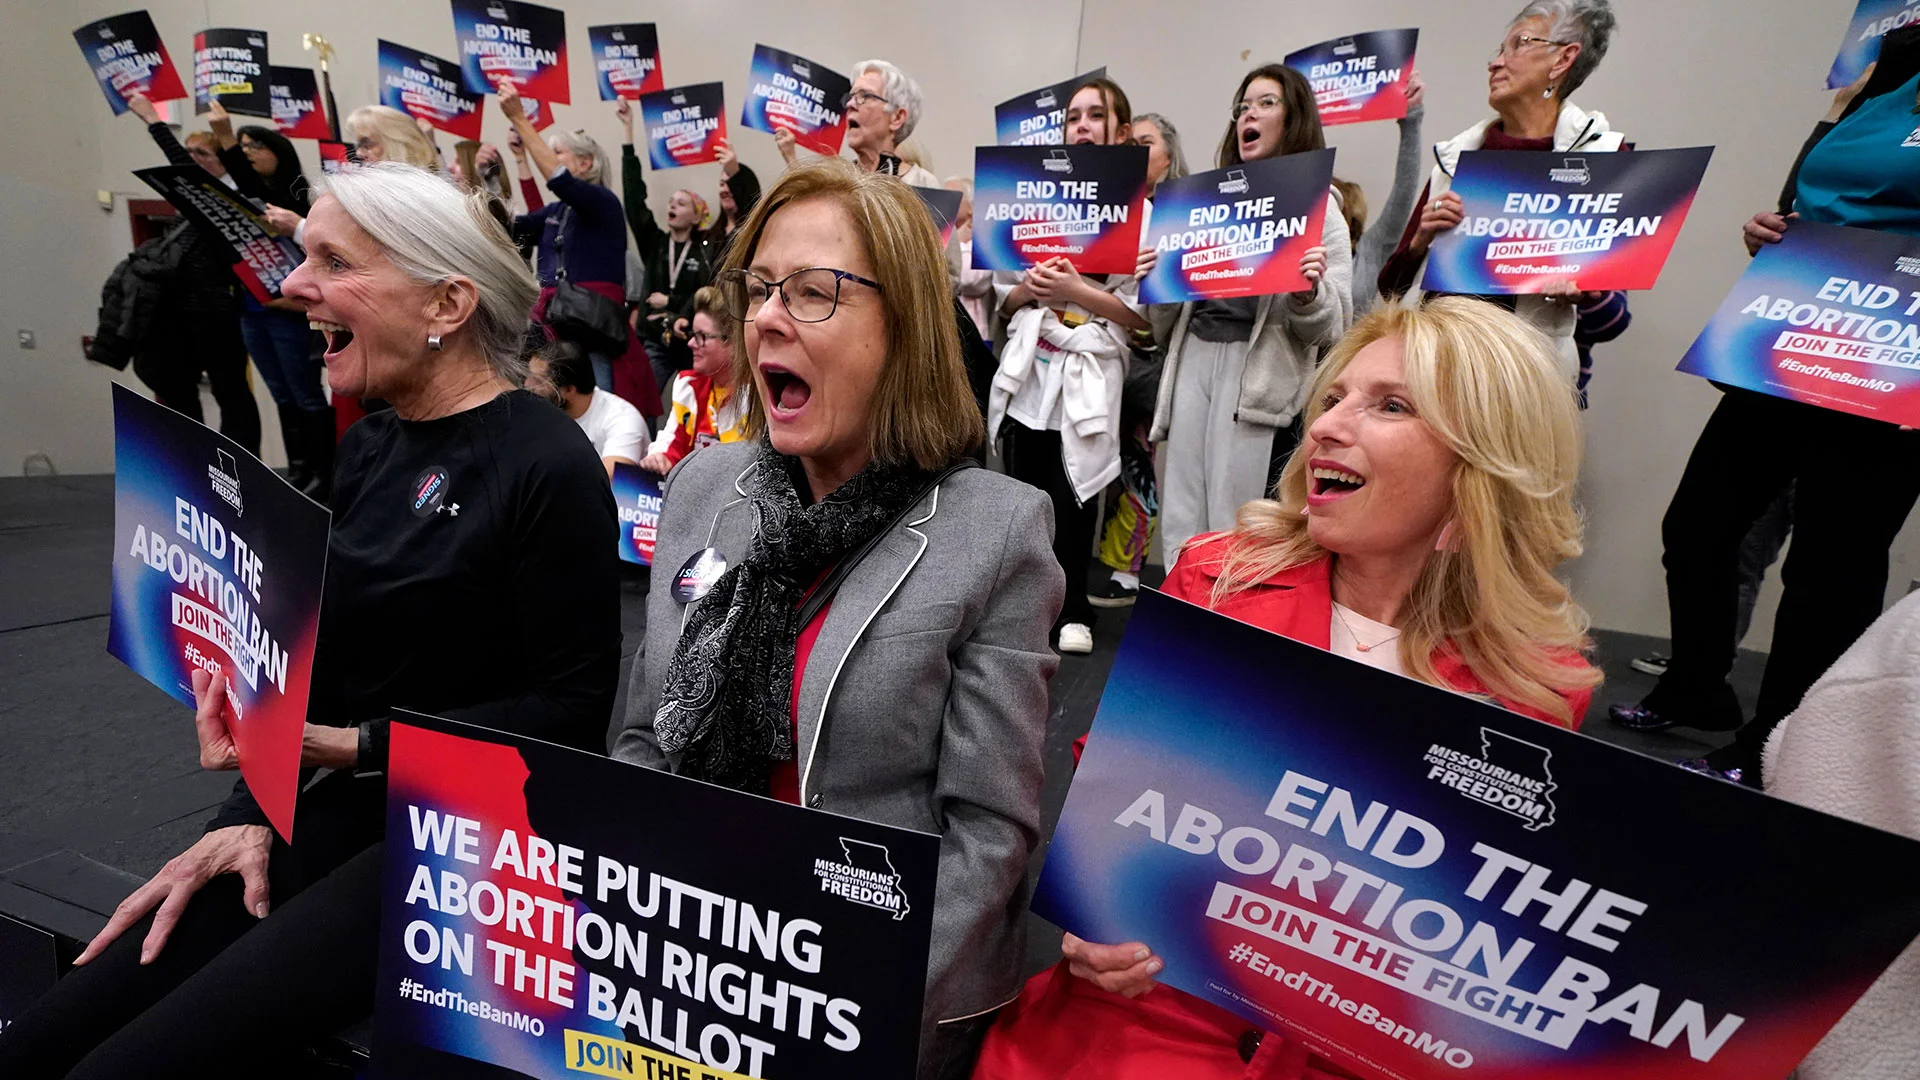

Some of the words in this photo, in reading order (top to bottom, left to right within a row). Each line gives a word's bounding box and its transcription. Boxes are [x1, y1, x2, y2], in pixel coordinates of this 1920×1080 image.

[475, 23, 499, 39] END
[501, 25, 531, 44] THE
[1858, 5, 1920, 41] ABOR
[463, 40, 521, 59] ABORTION
[524, 48, 558, 66] BAN
[1311, 61, 1343, 78] END
[1345, 56, 1377, 73] THE
[385, 75, 448, 103] ABORTION
[448, 95, 476, 114] BAN
[402, 66, 429, 83] END
[431, 75, 458, 93] THE
[772, 72, 798, 90] END
[799, 81, 826, 103] THE
[1310, 73, 1364, 94] ORTION
[1366, 68, 1401, 85] BAN
[662, 109, 681, 124] END
[681, 105, 702, 119] THE
[752, 83, 813, 113] ABORTION
[814, 104, 841, 127] BAN
[697, 117, 719, 131] BAN
[1017, 126, 1065, 146] ORTION
[1020, 114, 1047, 135] END
[1049, 108, 1067, 126] TH
[1016, 181, 1056, 199] END
[1060, 181, 1099, 200] THE
[1503, 193, 1562, 214] END
[1567, 193, 1623, 215] THE
[984, 203, 1085, 222] ABORTION
[1087, 203, 1129, 224] BAN
[1188, 204, 1230, 227] END
[1234, 196, 1276, 221] THE
[1454, 216, 1592, 239] ABORTION
[1598, 215, 1662, 238] BAN
[1017, 224, 1039, 237] JOIN
[1042, 223, 1061, 235] THE
[1064, 222, 1095, 233] FIGHT
[1156, 222, 1256, 254] ABORTION
[1261, 216, 1307, 241] BAN
[239, 231, 284, 282] BORTION
[1185, 253, 1209, 267] JOIN
[1212, 247, 1232, 260] THE
[1235, 239, 1269, 256] FIGHT
[1491, 245, 1525, 258] JOIN
[1529, 243, 1557, 256] THE
[1560, 238, 1607, 252] FIGHT
[1189, 267, 1254, 282] #EndTheBanMO
[1494, 264, 1581, 276] #EndTheBanMO
[1815, 276, 1900, 310] END
[1781, 335, 1829, 352] JOIN
[1835, 342, 1874, 359] THE
[1877, 348, 1920, 366] FIGH
[1778, 357, 1897, 394] #EndTheBanMO
[212, 480, 241, 509] FREEDOM
[415, 477, 442, 509] SIGNED
[618, 506, 660, 528] ABORT
[175, 496, 227, 560] END
[230, 530, 264, 604] THE
[130, 524, 250, 636] ABORTION
[250, 611, 289, 696] BAN
[177, 601, 210, 634] JOIN
[213, 618, 234, 651] THE
[233, 635, 257, 678] FIGHT
[1423, 754, 1446, 768] FOR
[1446, 761, 1538, 802] CONSTITUTIONAL
[1428, 743, 1546, 794] MISSOURIANS
[1427, 765, 1546, 820] FREEDOM
[814, 858, 894, 887] MISSOURIANS
[1264, 769, 1446, 869] END
[1463, 841, 1649, 953] THE
[407, 805, 481, 865] WE
[491, 829, 585, 895] ARE
[597, 855, 823, 974] PUTTING
[814, 868, 829, 879] FOR
[829, 872, 893, 894] CONSTITUTIONAL
[821, 877, 901, 910] FREEDOM
[1114, 789, 1536, 990] ABORTION
[1540, 958, 1746, 1064] BAN
[405, 865, 648, 978] ABORTION
[662, 941, 862, 1052] RIGHTS
[1221, 896, 1319, 945] JOIN
[1331, 929, 1415, 979] THE
[1423, 968, 1568, 1035] FIGHT
[399, 977, 545, 1037] #EndTheBanMO
[404, 920, 475, 977] ON
[486, 940, 577, 1010] THE
[587, 972, 775, 1079] BALLOT
[1228, 942, 1475, 1070] #EndTheBanMO
[576, 1039, 633, 1074] JOIN
[641, 1054, 691, 1080] THE
